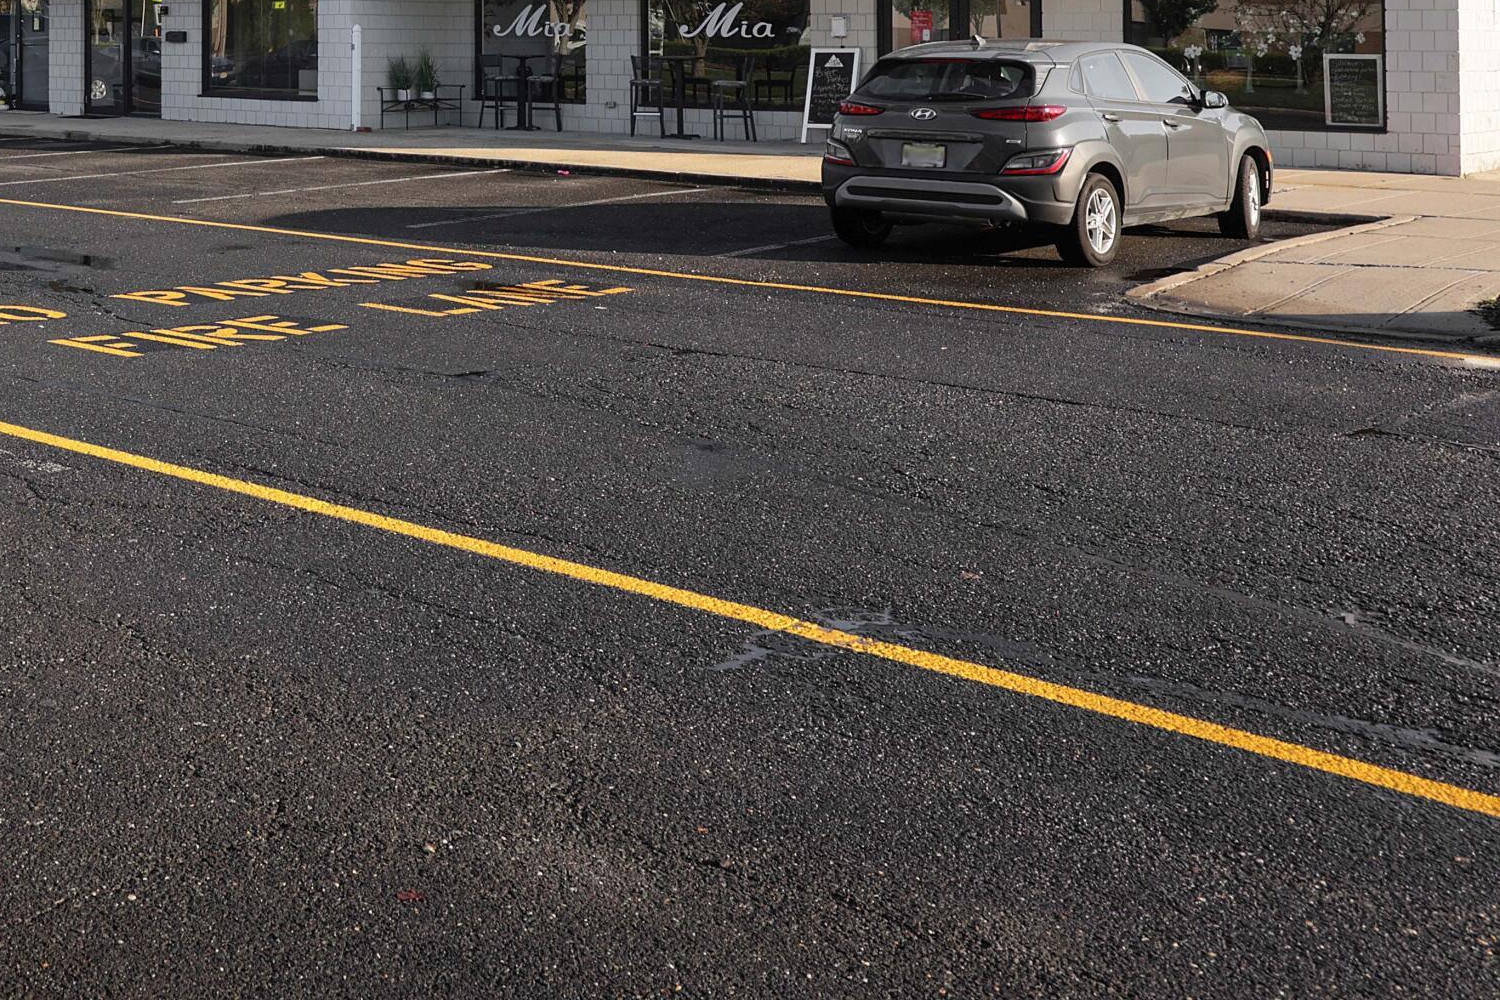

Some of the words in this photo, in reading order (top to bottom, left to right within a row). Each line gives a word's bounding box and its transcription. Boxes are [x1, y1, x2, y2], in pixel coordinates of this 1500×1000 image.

[493, 3, 573, 37] Mia
[680, 2, 775, 38] Mia
[108, 258, 493, 307] PARKING
[46, 315, 350, 358] FIRE
[358, 279, 635, 316] LANE
